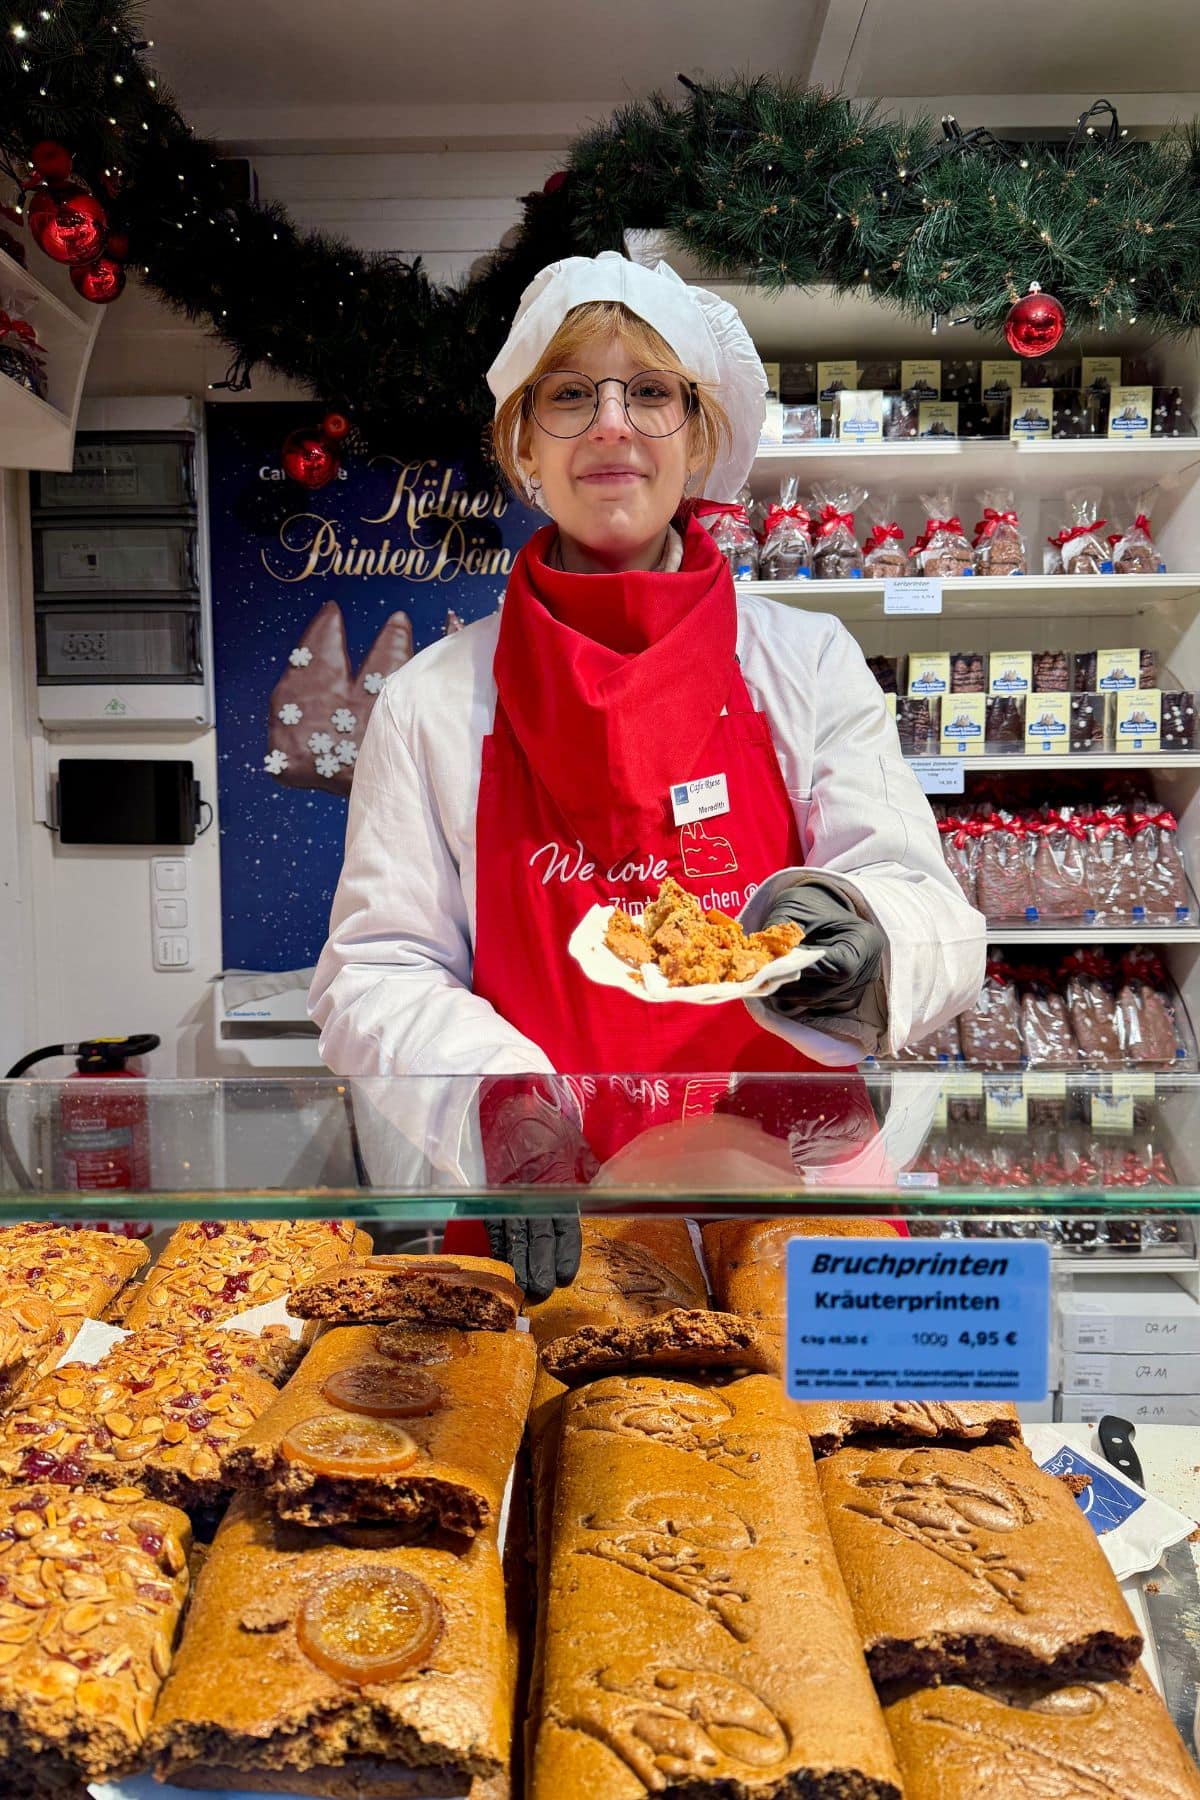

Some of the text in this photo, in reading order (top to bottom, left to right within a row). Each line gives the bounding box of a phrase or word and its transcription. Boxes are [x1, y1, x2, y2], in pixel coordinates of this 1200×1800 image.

[360, 454, 509, 529] Kölner
[261, 512, 430, 582] Printen
[698, 801, 725, 814] Meredith
[529, 839, 594, 885] We
[811, 1253, 1008, 1278] Bruchprinten
[814, 1290, 1000, 1312] Kräuterprinten
[912, 1331, 1018, 1348] 100g 4,95 €
